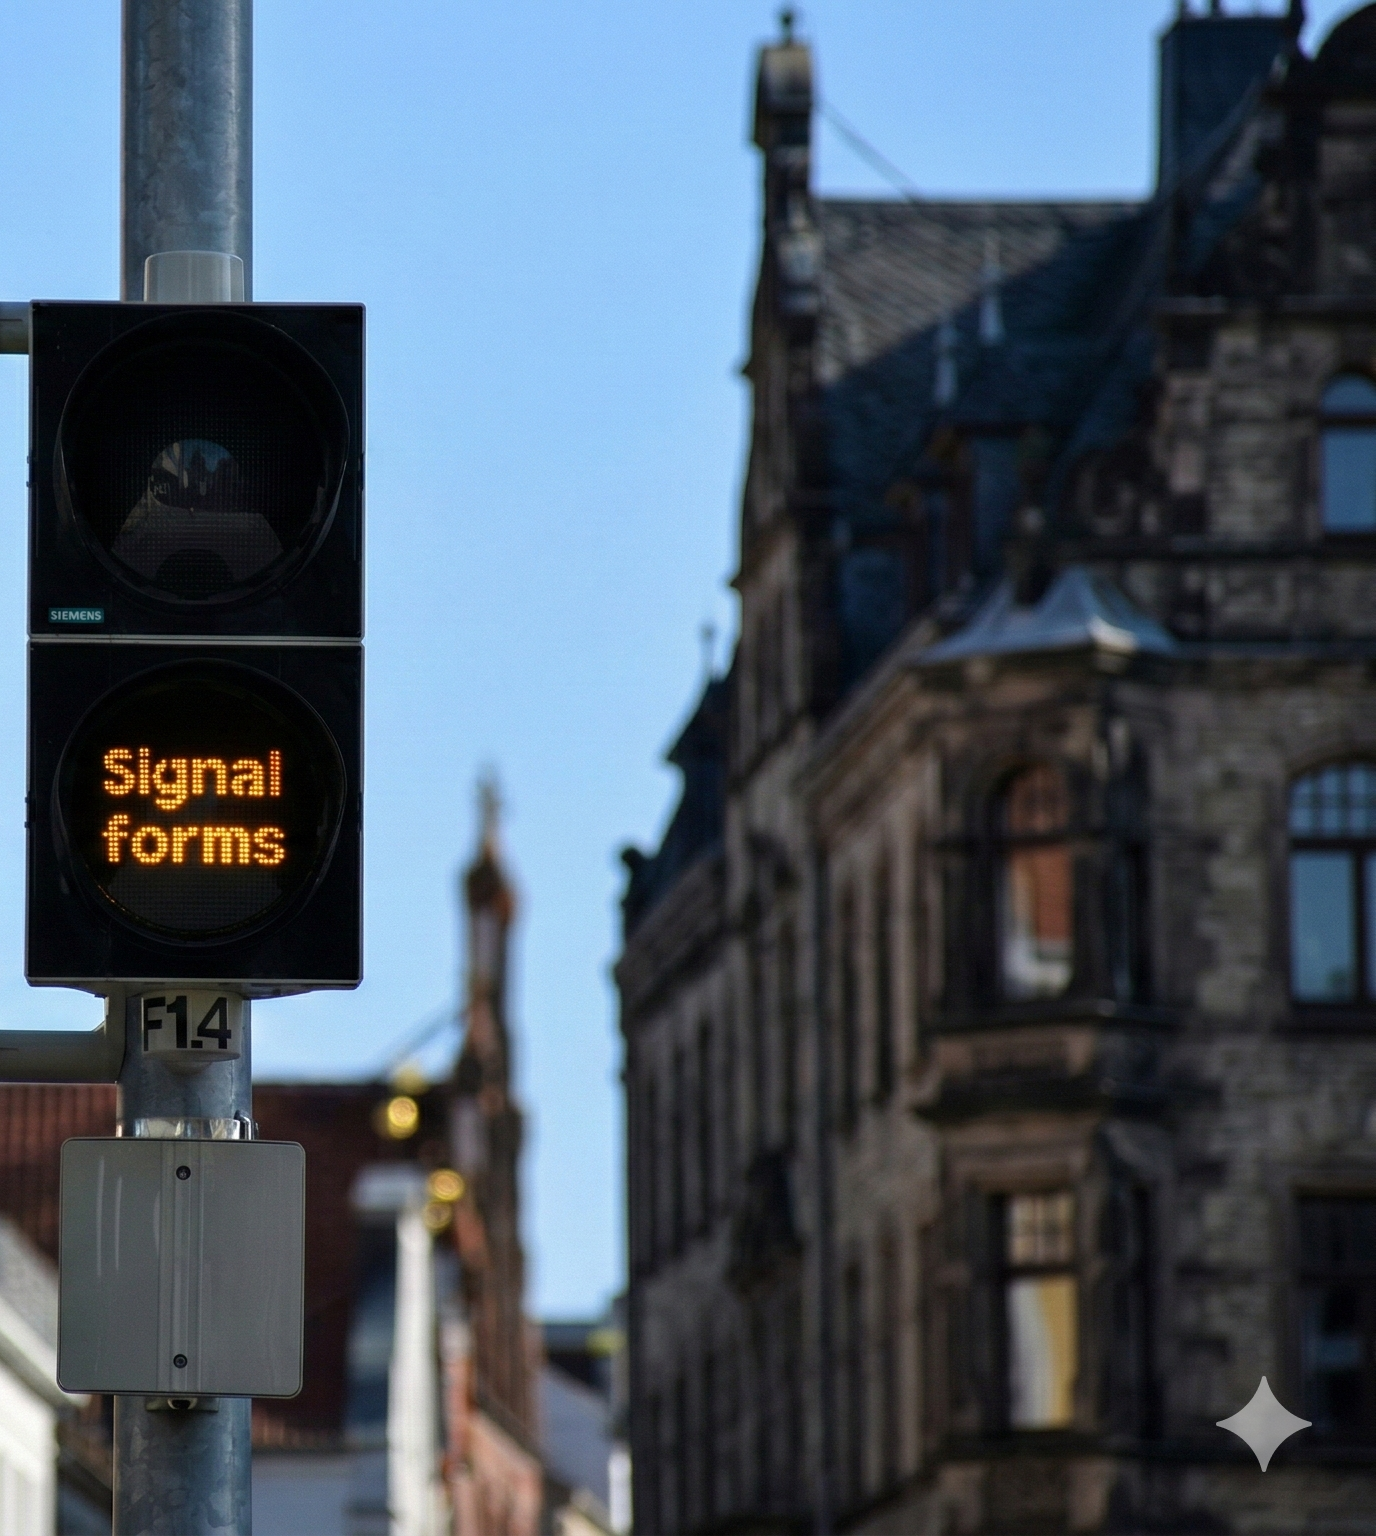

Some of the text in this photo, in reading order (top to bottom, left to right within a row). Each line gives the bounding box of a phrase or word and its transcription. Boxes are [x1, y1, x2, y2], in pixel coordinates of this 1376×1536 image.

[50, 610, 102, 621] SIEMENS
[103, 746, 281, 811] Signal
[102, 813, 285, 865] forms
[143, 995, 232, 1052] F1.4
